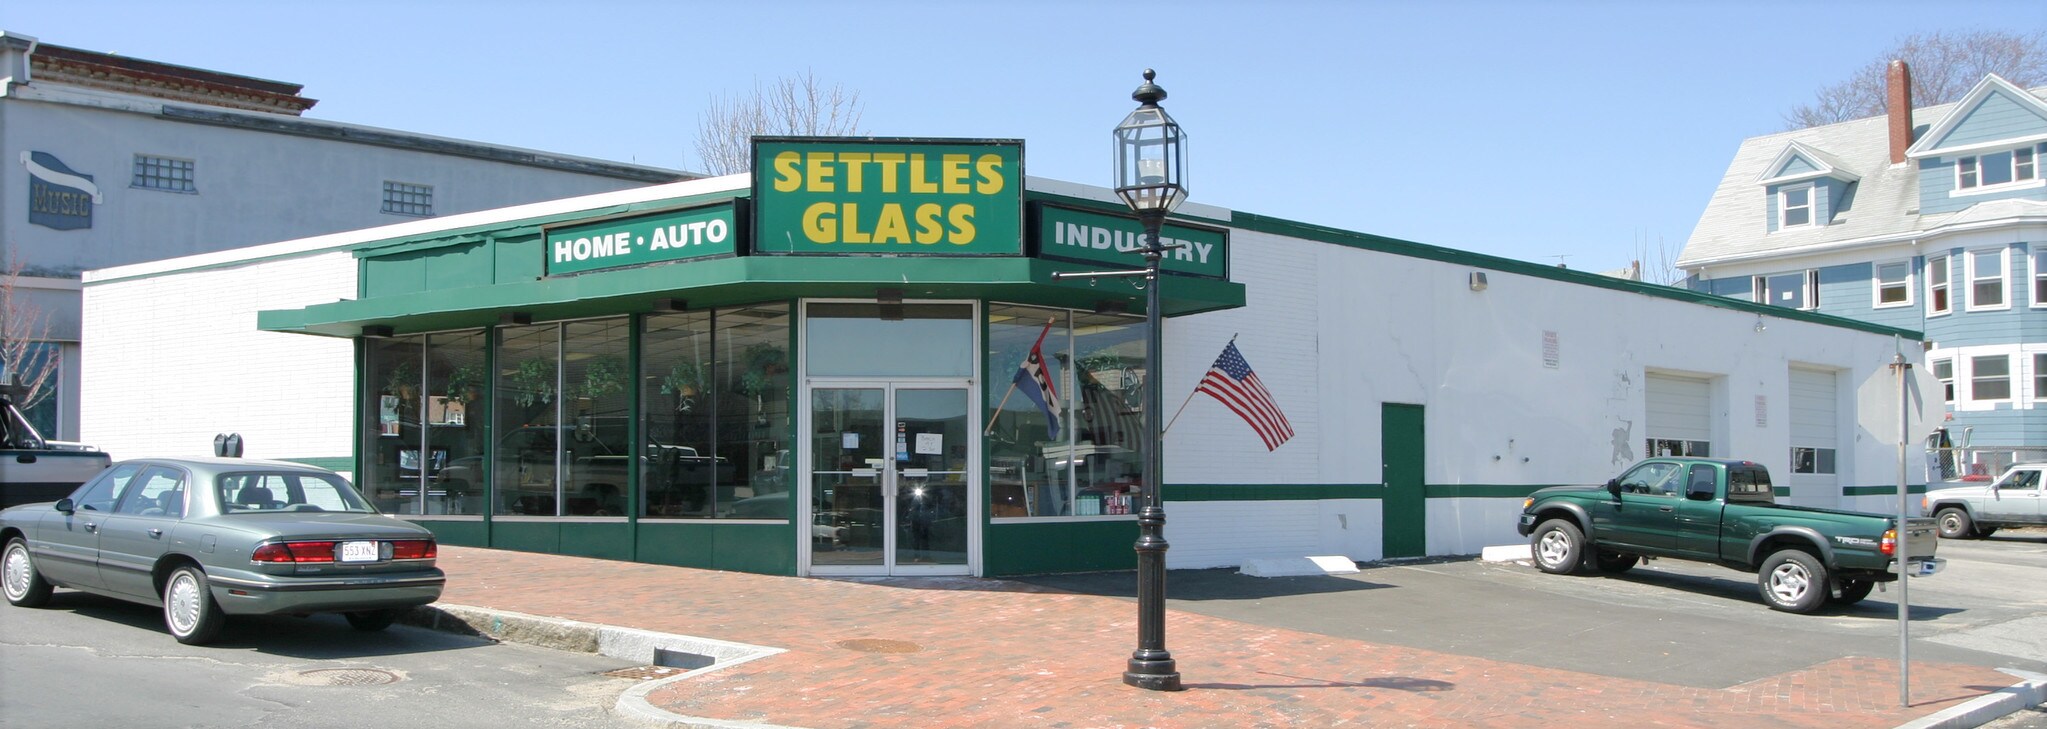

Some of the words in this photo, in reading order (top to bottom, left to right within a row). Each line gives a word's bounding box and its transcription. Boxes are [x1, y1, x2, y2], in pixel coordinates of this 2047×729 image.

[774, 151, 1004, 195] SETTLES
[32, 183, 89, 217] MUSIC
[555, 232, 631, 263] HOME
[650, 219, 728, 251] AUTO
[802, 202, 976, 245] GLASS
[344, 545, 360, 556] 553
[1834, 536, 1860, 545] TRD
